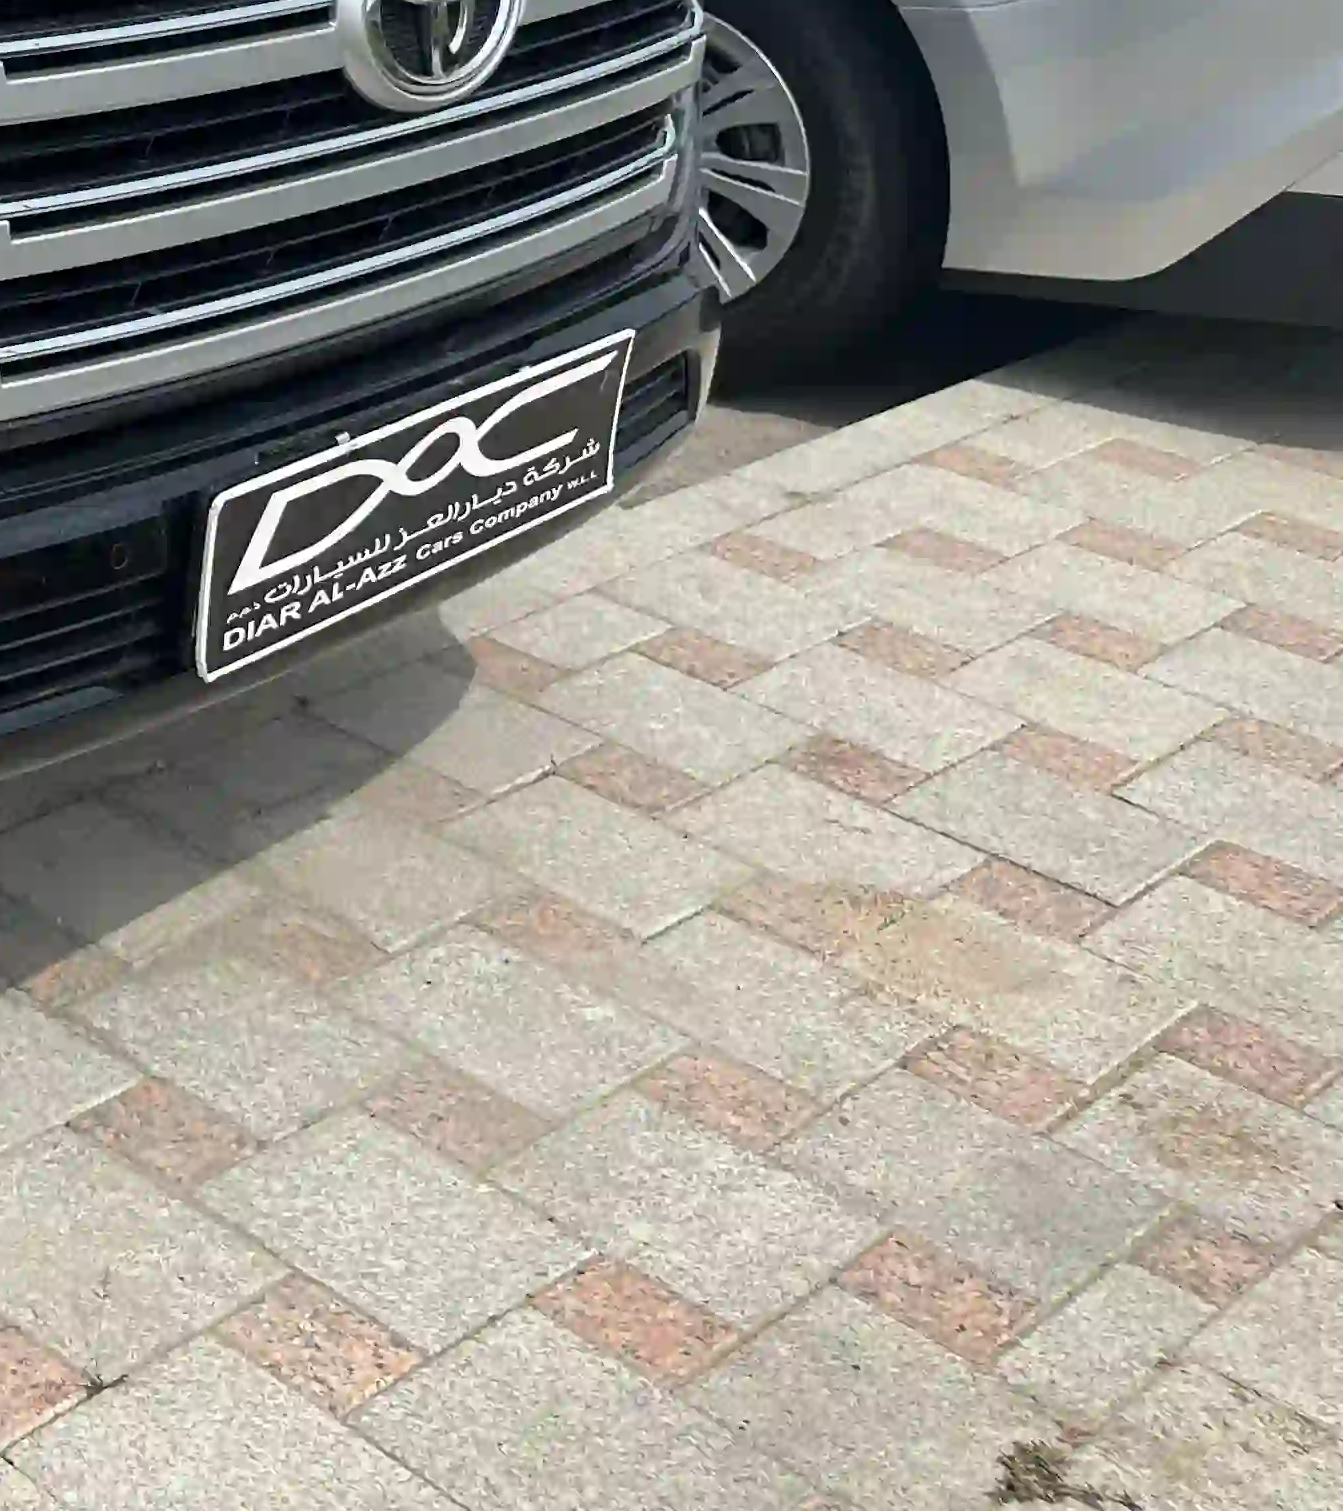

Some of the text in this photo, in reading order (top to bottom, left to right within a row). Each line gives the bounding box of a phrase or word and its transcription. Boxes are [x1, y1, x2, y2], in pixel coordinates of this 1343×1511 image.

[522, 437, 601, 487] شركة
[223, 601, 302, 651] DIAR
[415, 530, 464, 561] Cars
[468, 483, 564, 536] Company
[264, 532, 392, 604] للسيارات
